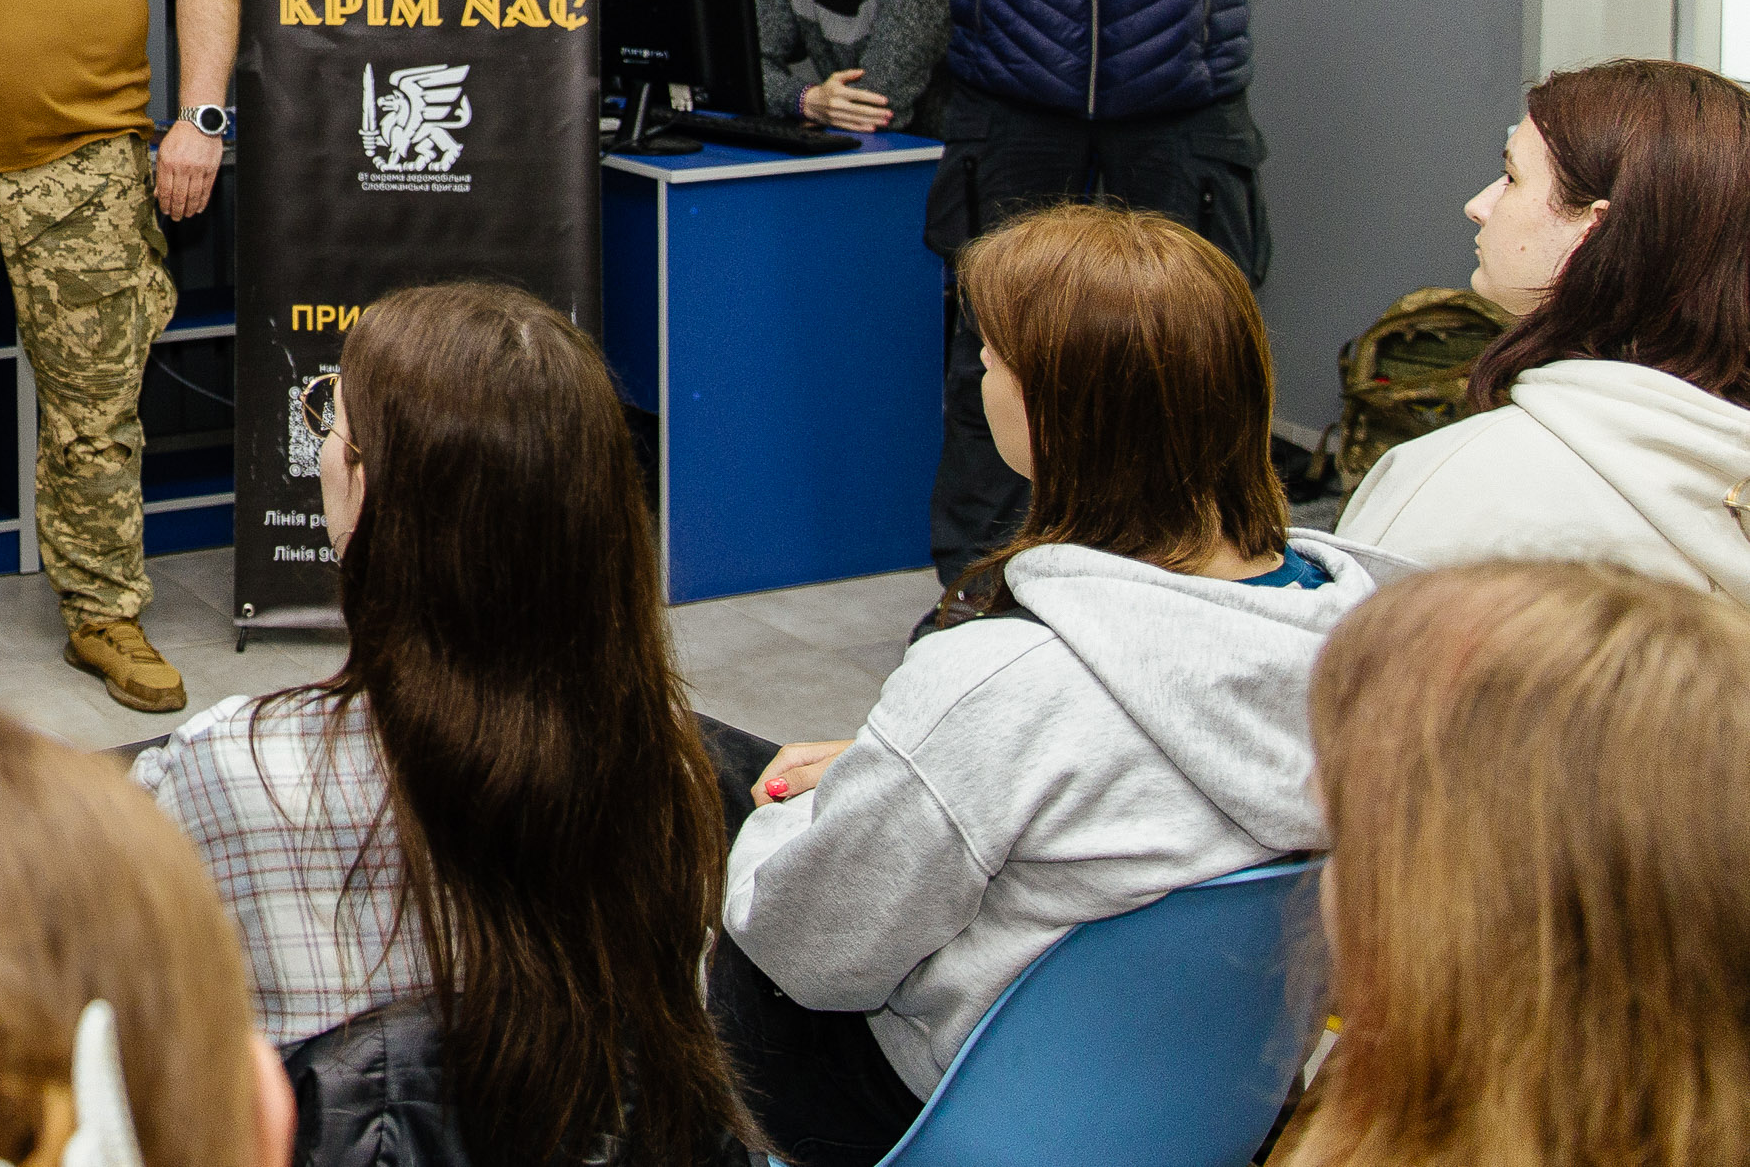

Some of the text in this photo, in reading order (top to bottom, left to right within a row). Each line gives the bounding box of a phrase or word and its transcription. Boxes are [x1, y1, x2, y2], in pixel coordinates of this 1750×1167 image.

[292, 305, 373, 331] ПРИ
[263, 510, 306, 526] Лінія
[273, 544, 316, 562] Лінія
